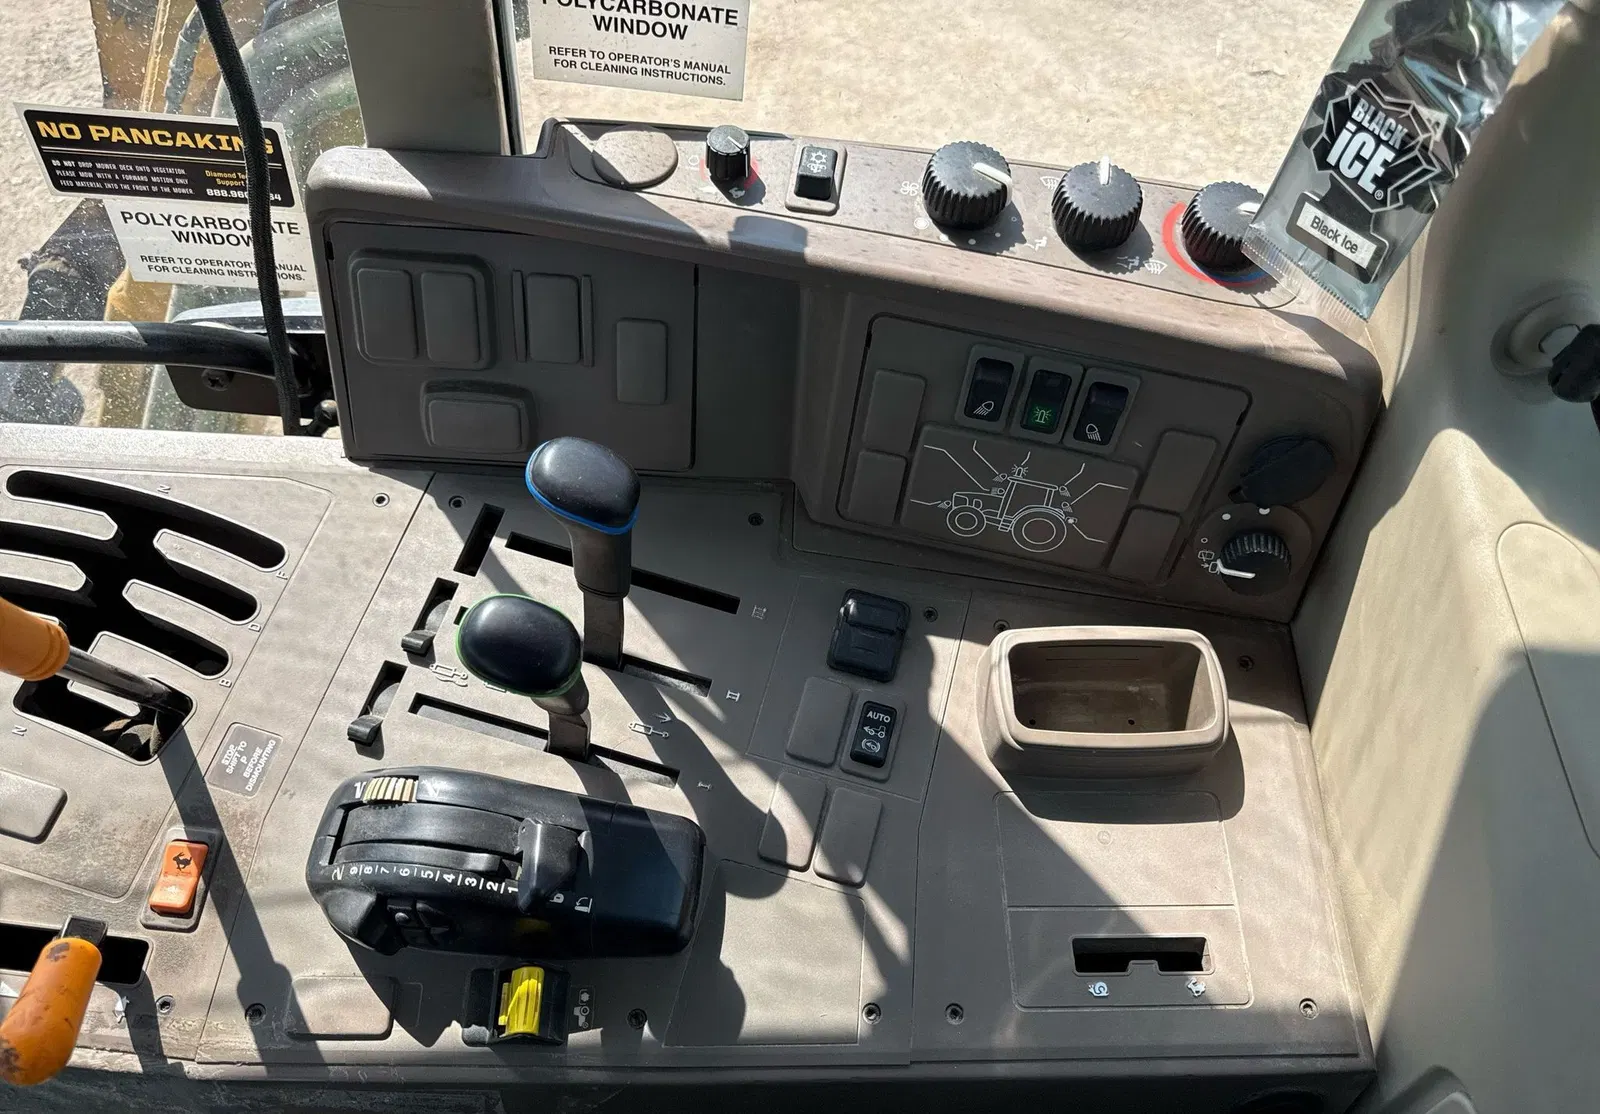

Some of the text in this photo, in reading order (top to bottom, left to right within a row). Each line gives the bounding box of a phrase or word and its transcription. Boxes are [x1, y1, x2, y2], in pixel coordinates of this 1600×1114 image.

[542, 0, 739, 26] LYCARBONATE
[592, 15, 688, 40] WINDOW
[548, 46, 732, 74] REFER TO OPERATOR'S MANUAL
[554, 58, 726, 86] FOR CLEANING INSTRUCTIONS.
[36, 121, 82, 139] NO
[1351, 98, 1409, 150] BLACK
[95, 162, 117, 171] MOWER
[119, 164, 134, 172] DECK
[205, 170, 236, 178] Diamond
[75, 180, 102, 189] MATERIAL
[132, 184, 150, 192] FRONT
[122, 174, 148, 182] FORWARD
[216, 178, 245, 186] Support
[120, 210, 301, 235] POLYCARBOTE
[1310, 215, 1358, 254] Black Ice
[140, 255, 176, 264] REFER
[178, 257, 192, 265] TO
[194, 258, 255, 269] OPERATOR'
[148, 264, 306, 281] FOR CLEANING INSTRIONS.
[276, 570, 288, 580] F
[248, 622, 262, 632] D
[219, 679, 232, 688] B
[866, 710, 890, 722] AUTO
[221, 744, 236, 766] STOP
[226, 740, 247, 774] SHIFT TO
[240, 756, 248, 764] P
[243, 746, 262, 778] BEFORE
[245, 740, 276, 792] DISMOUNTING
[364, 866, 373, 874] 8
[400, 868, 410, 876] 6
[421, 870, 434, 878] 5
[443, 873, 456, 883] 4
[464, 877, 477, 887] 3
[486, 881, 499, 891] 2
[508, 885, 518, 894] 1
